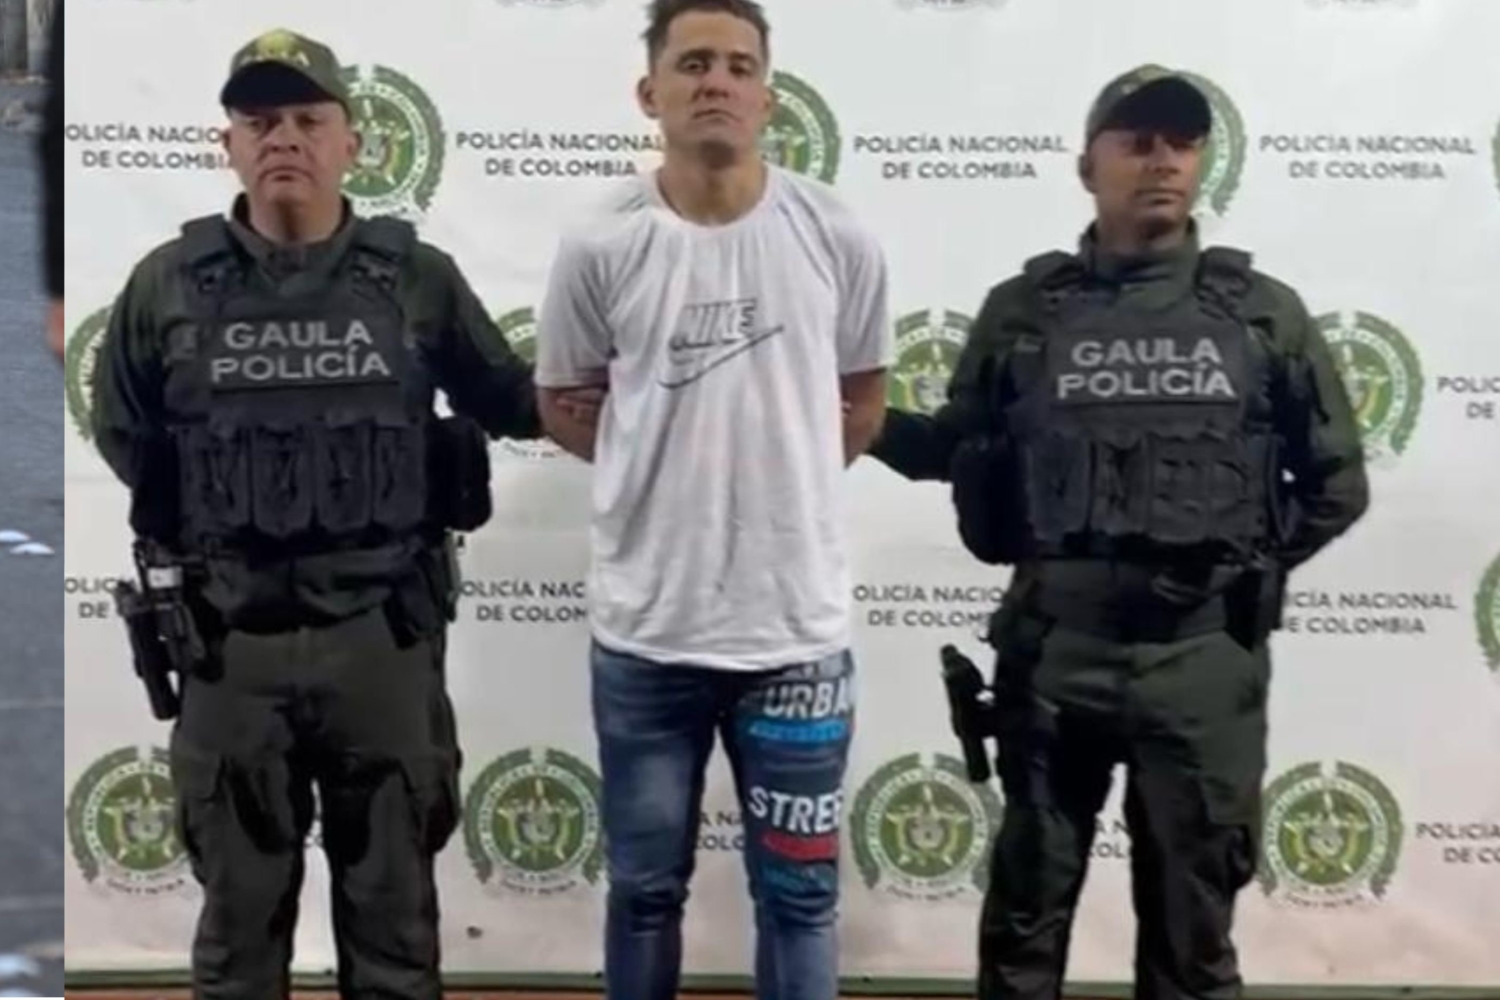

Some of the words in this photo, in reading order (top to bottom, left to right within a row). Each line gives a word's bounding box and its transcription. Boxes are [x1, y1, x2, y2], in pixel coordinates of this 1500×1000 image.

[65, 121, 141, 142] OLICÍA
[147, 125, 223, 144] NACIO
[456, 128, 544, 150] POLICÍA
[550, 132, 666, 151] NACIONAL
[853, 132, 942, 153] POLICÍA
[948, 134, 1071, 154] NACIONAL
[1356, 134, 1477, 155] NACIONAL
[82, 150, 112, 168] DE
[117, 150, 228, 170] COLOMBI
[485, 157, 515, 177] DE
[519, 157, 637, 177] COLOMBIA
[1289, 160, 1318, 179] DE
[1324, 160, 1445, 179] COLOMBIA
[882, 161, 912, 180] DE
[917, 161, 1037, 180] COLOMBIA
[224, 319, 373, 350] GAULA
[669, 297, 758, 352] NIKE
[1071, 337, 1223, 368] GAULA
[211, 344, 391, 384] POLICÍA
[1057, 361, 1237, 400] POLICÍA
[1437, 375, 1500, 394] POLIC
[1466, 401, 1495, 420] DE
[460, 578, 534, 598] OLICÍA
[541, 580, 586, 599] NAC
[853, 583, 927, 602] OLICÍA
[933, 585, 1004, 603] NACIO
[78, 601, 110, 619] DE
[1338, 590, 1459, 610] NACIONAL
[477, 604, 503, 622] DE
[511, 605, 588, 622] COLOM
[868, 609, 897, 627] DE
[903, 609, 986, 628] COLOM
[1286, 616, 1300, 633] E
[1306, 616, 1426, 634] COLOMBIA
[763, 679, 848, 719] URBA
[747, 786, 842, 834] STRE
[1443, 846, 1473, 865] DE
